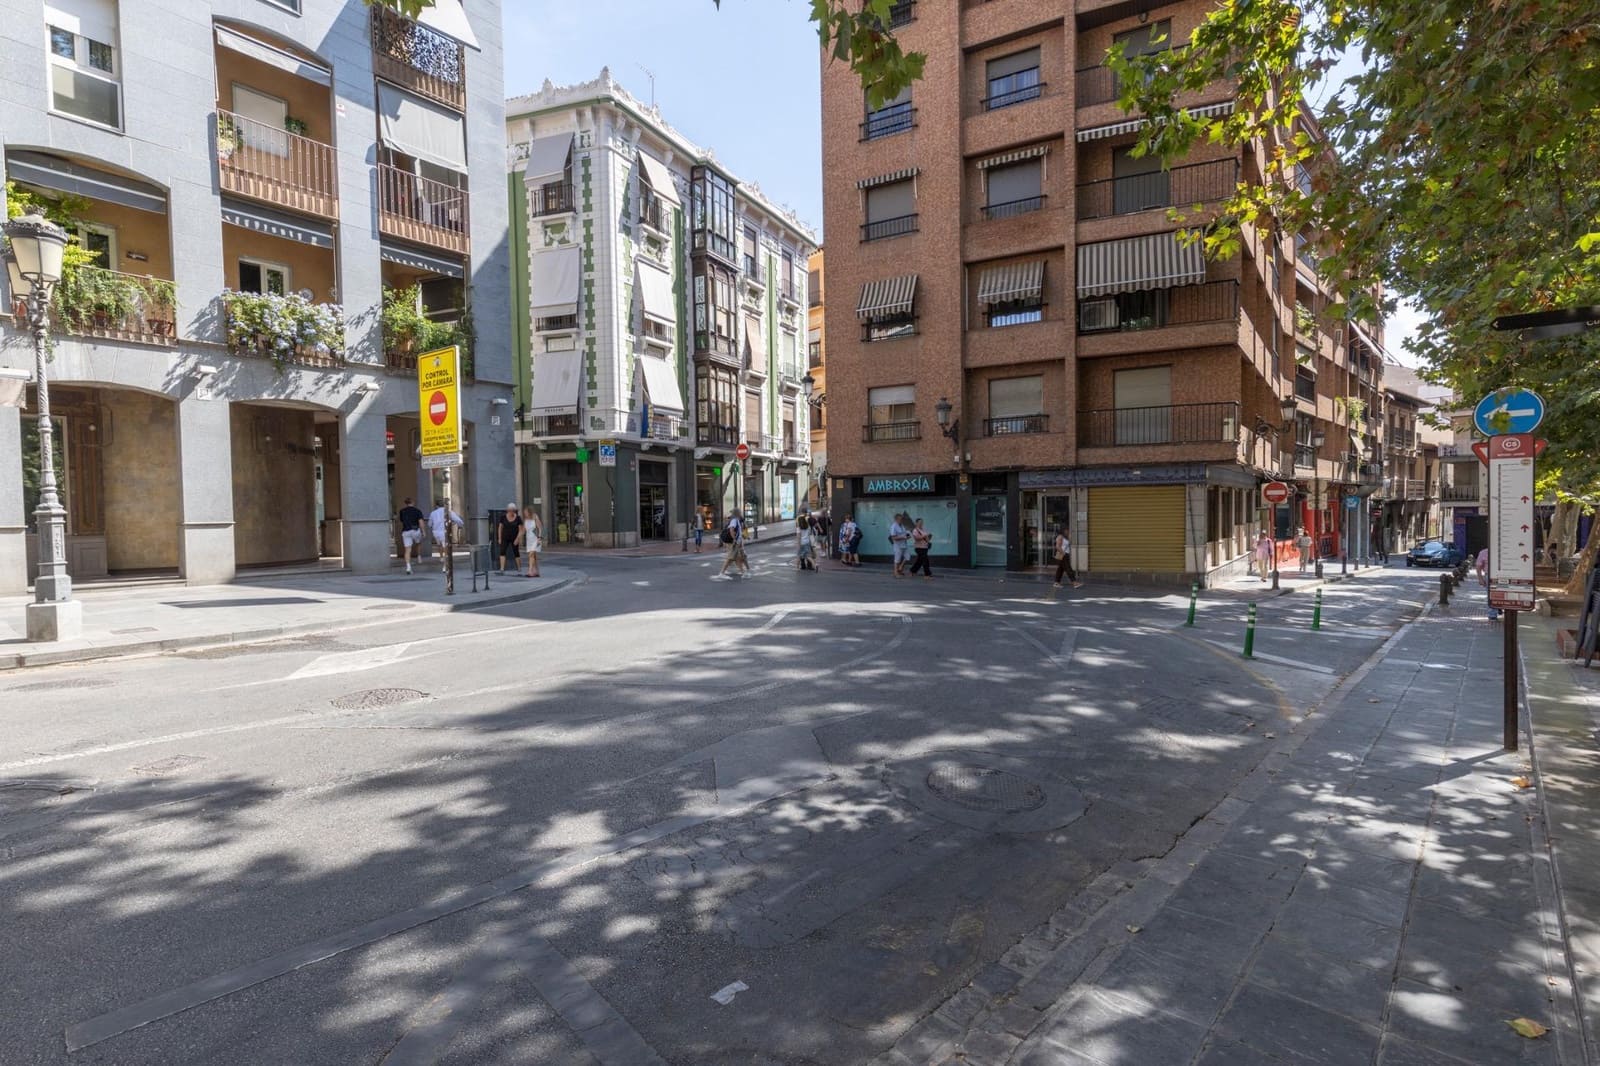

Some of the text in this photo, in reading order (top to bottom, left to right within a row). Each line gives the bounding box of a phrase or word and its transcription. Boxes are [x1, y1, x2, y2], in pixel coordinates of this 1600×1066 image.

[425, 369, 448, 380] CONTROL
[422, 380, 432, 389] POR
[867, 475, 930, 492] AMBROSÍA
